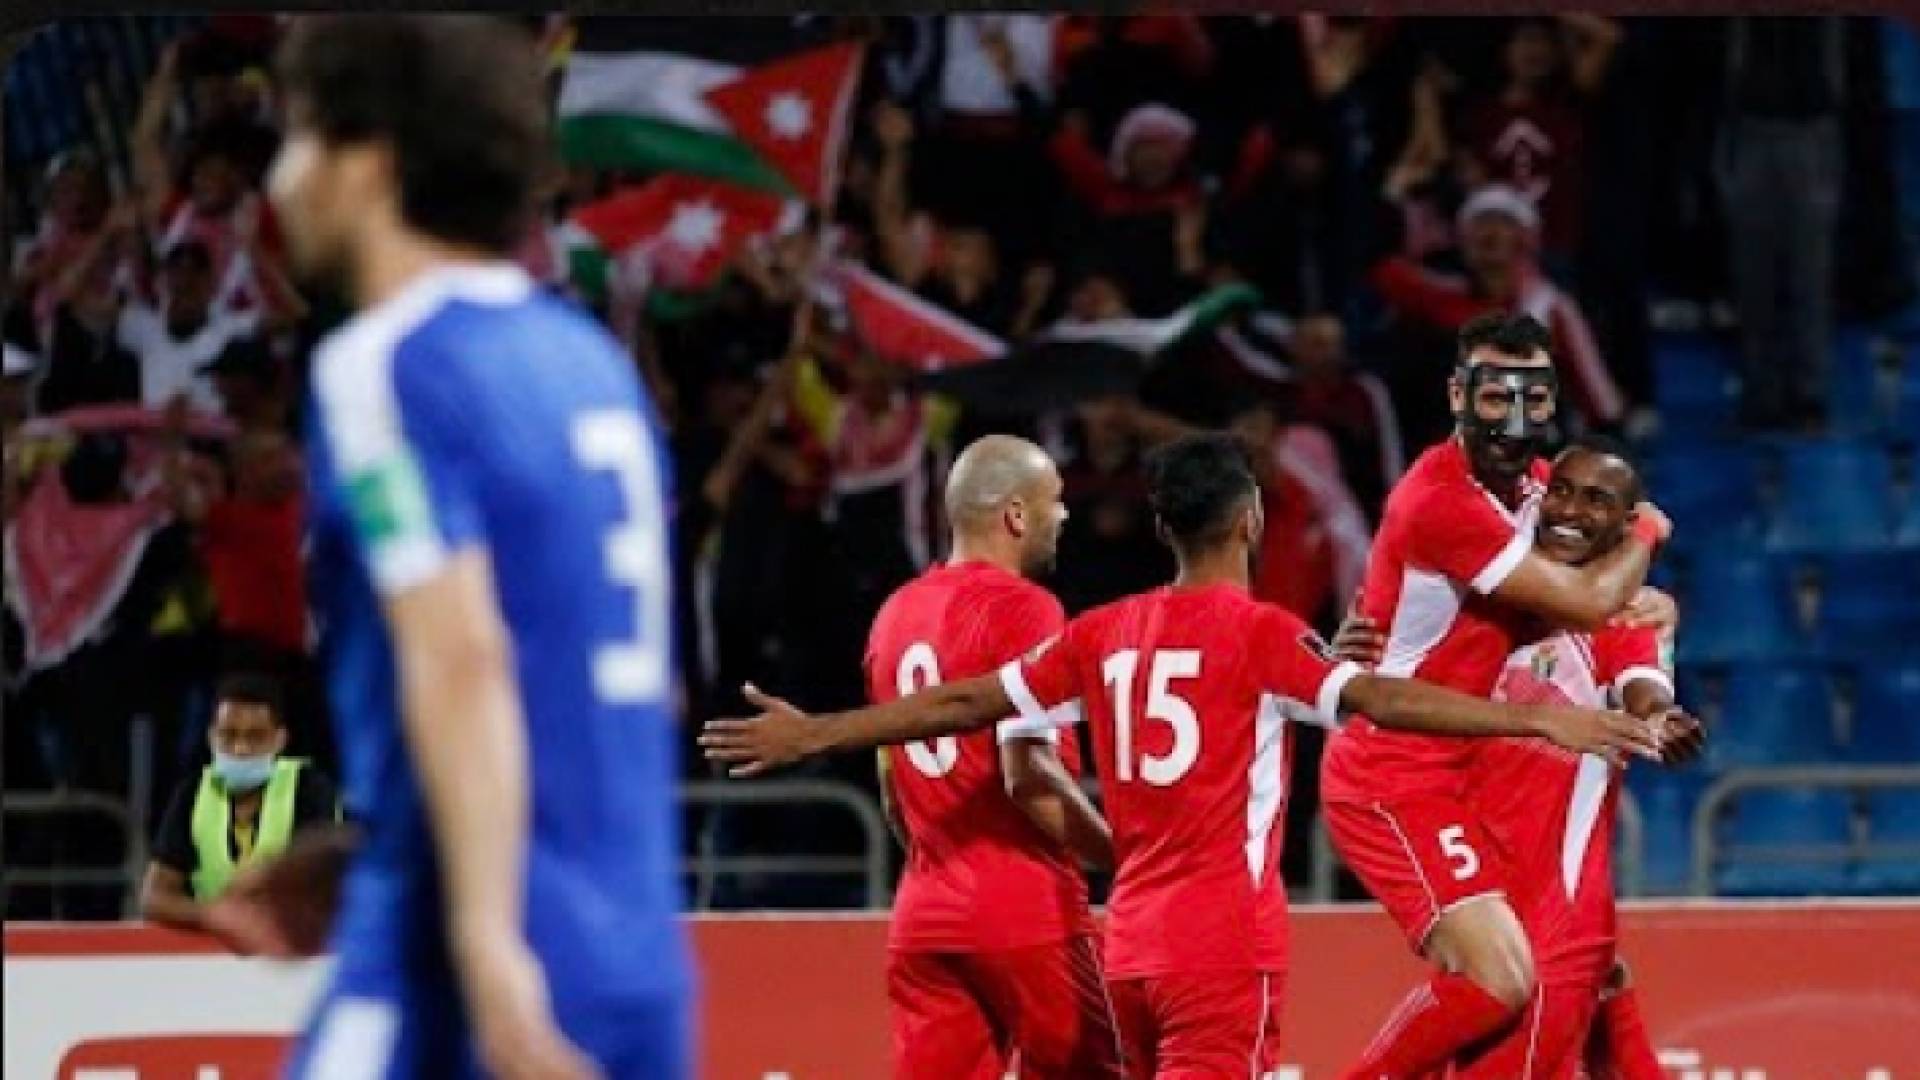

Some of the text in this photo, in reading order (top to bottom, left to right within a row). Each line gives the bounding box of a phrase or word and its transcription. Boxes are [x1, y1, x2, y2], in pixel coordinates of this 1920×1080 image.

[572, 411, 671, 703] 3
[1103, 648, 1202, 786] 15
[1438, 825, 1480, 880] 5
